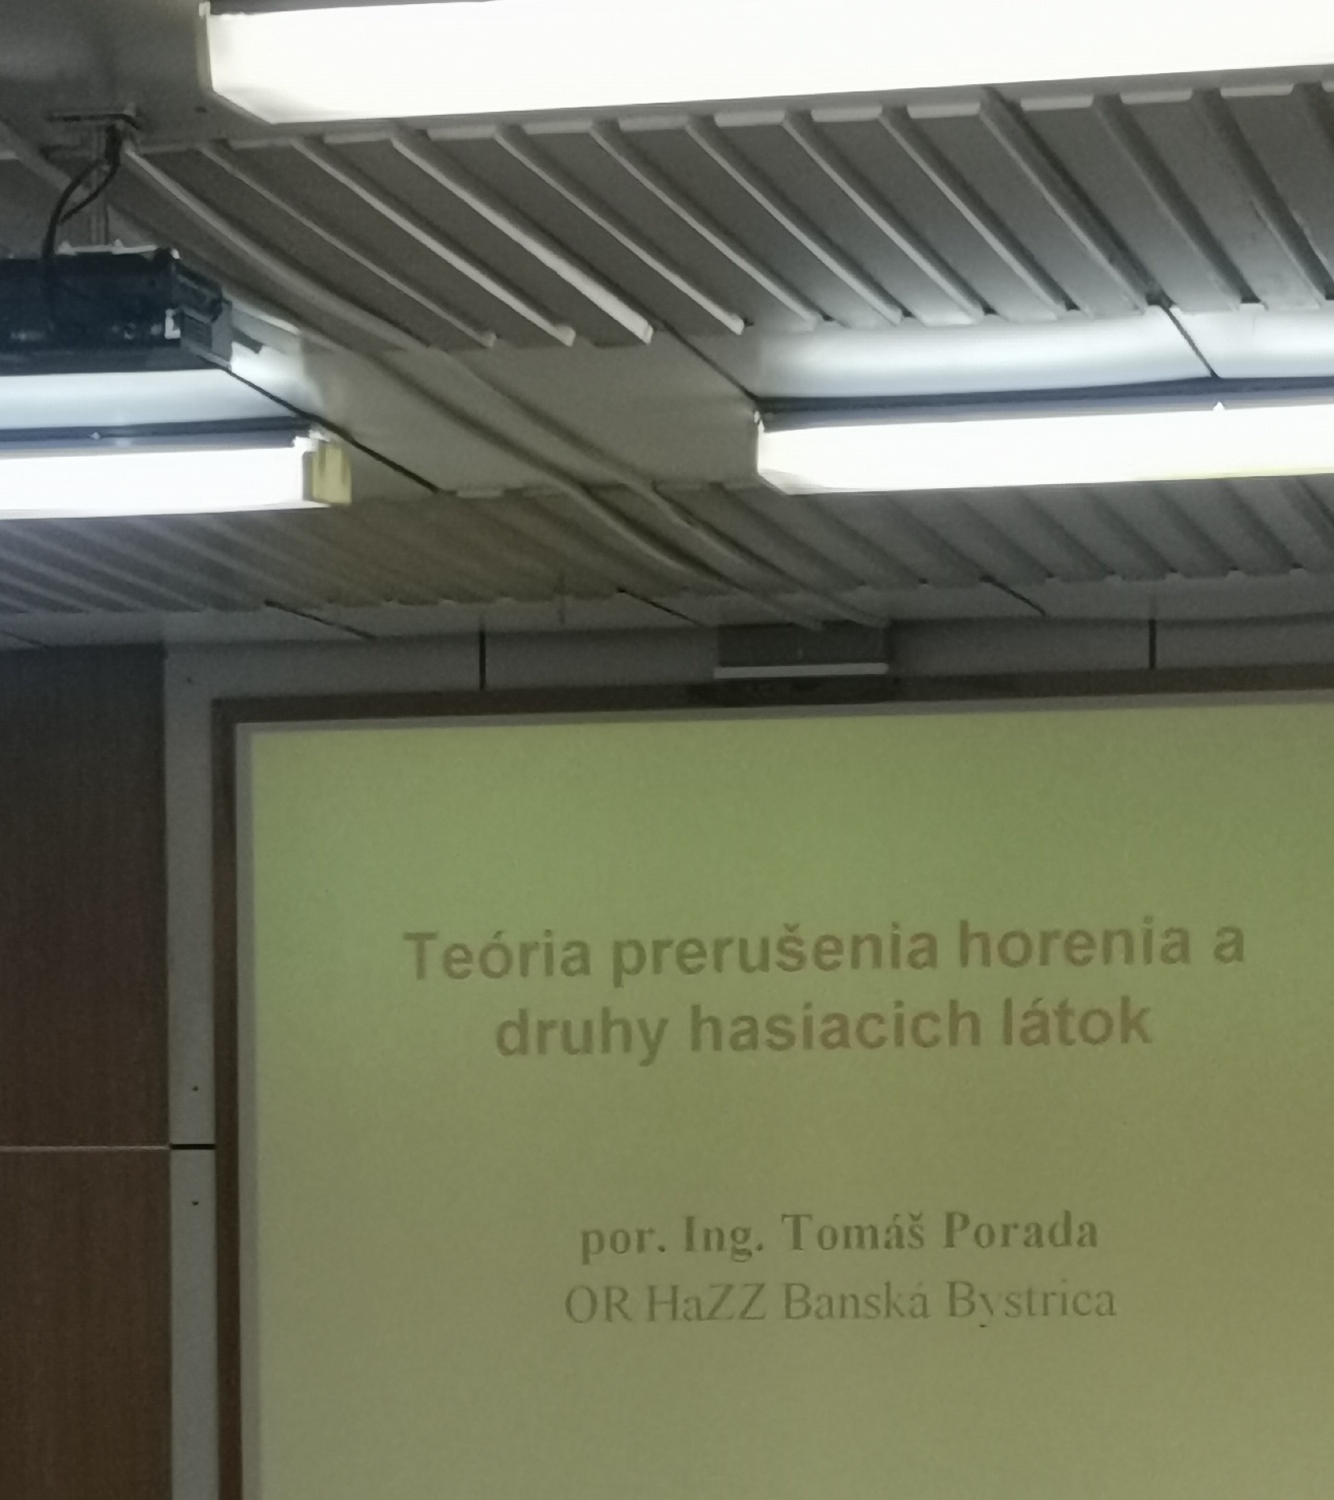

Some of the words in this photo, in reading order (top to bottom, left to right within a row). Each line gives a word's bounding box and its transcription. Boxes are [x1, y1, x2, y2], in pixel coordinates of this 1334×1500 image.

[402, 929, 590, 980] Teória
[613, 921, 937, 988] prerušenia
[959, 916, 1190, 968] horenia
[1213, 925, 1245, 964] a
[496, 1007, 668, 1067] druhy
[691, 999, 980, 1052] hasiacich
[1003, 995, 1152, 1047] látok
[581, 1228, 666, 1265] por.
[685, 1215, 764, 1263] Ing.
[781, 1212, 925, 1250] Tomáš
[944, 1209, 1098, 1249] Porada
[564, 1285, 632, 1323] OR
[647, 1282, 765, 1322] HaZZ
[784, 1281, 930, 1320] Banská
[948, 1279, 1116, 1329] Bystrica
